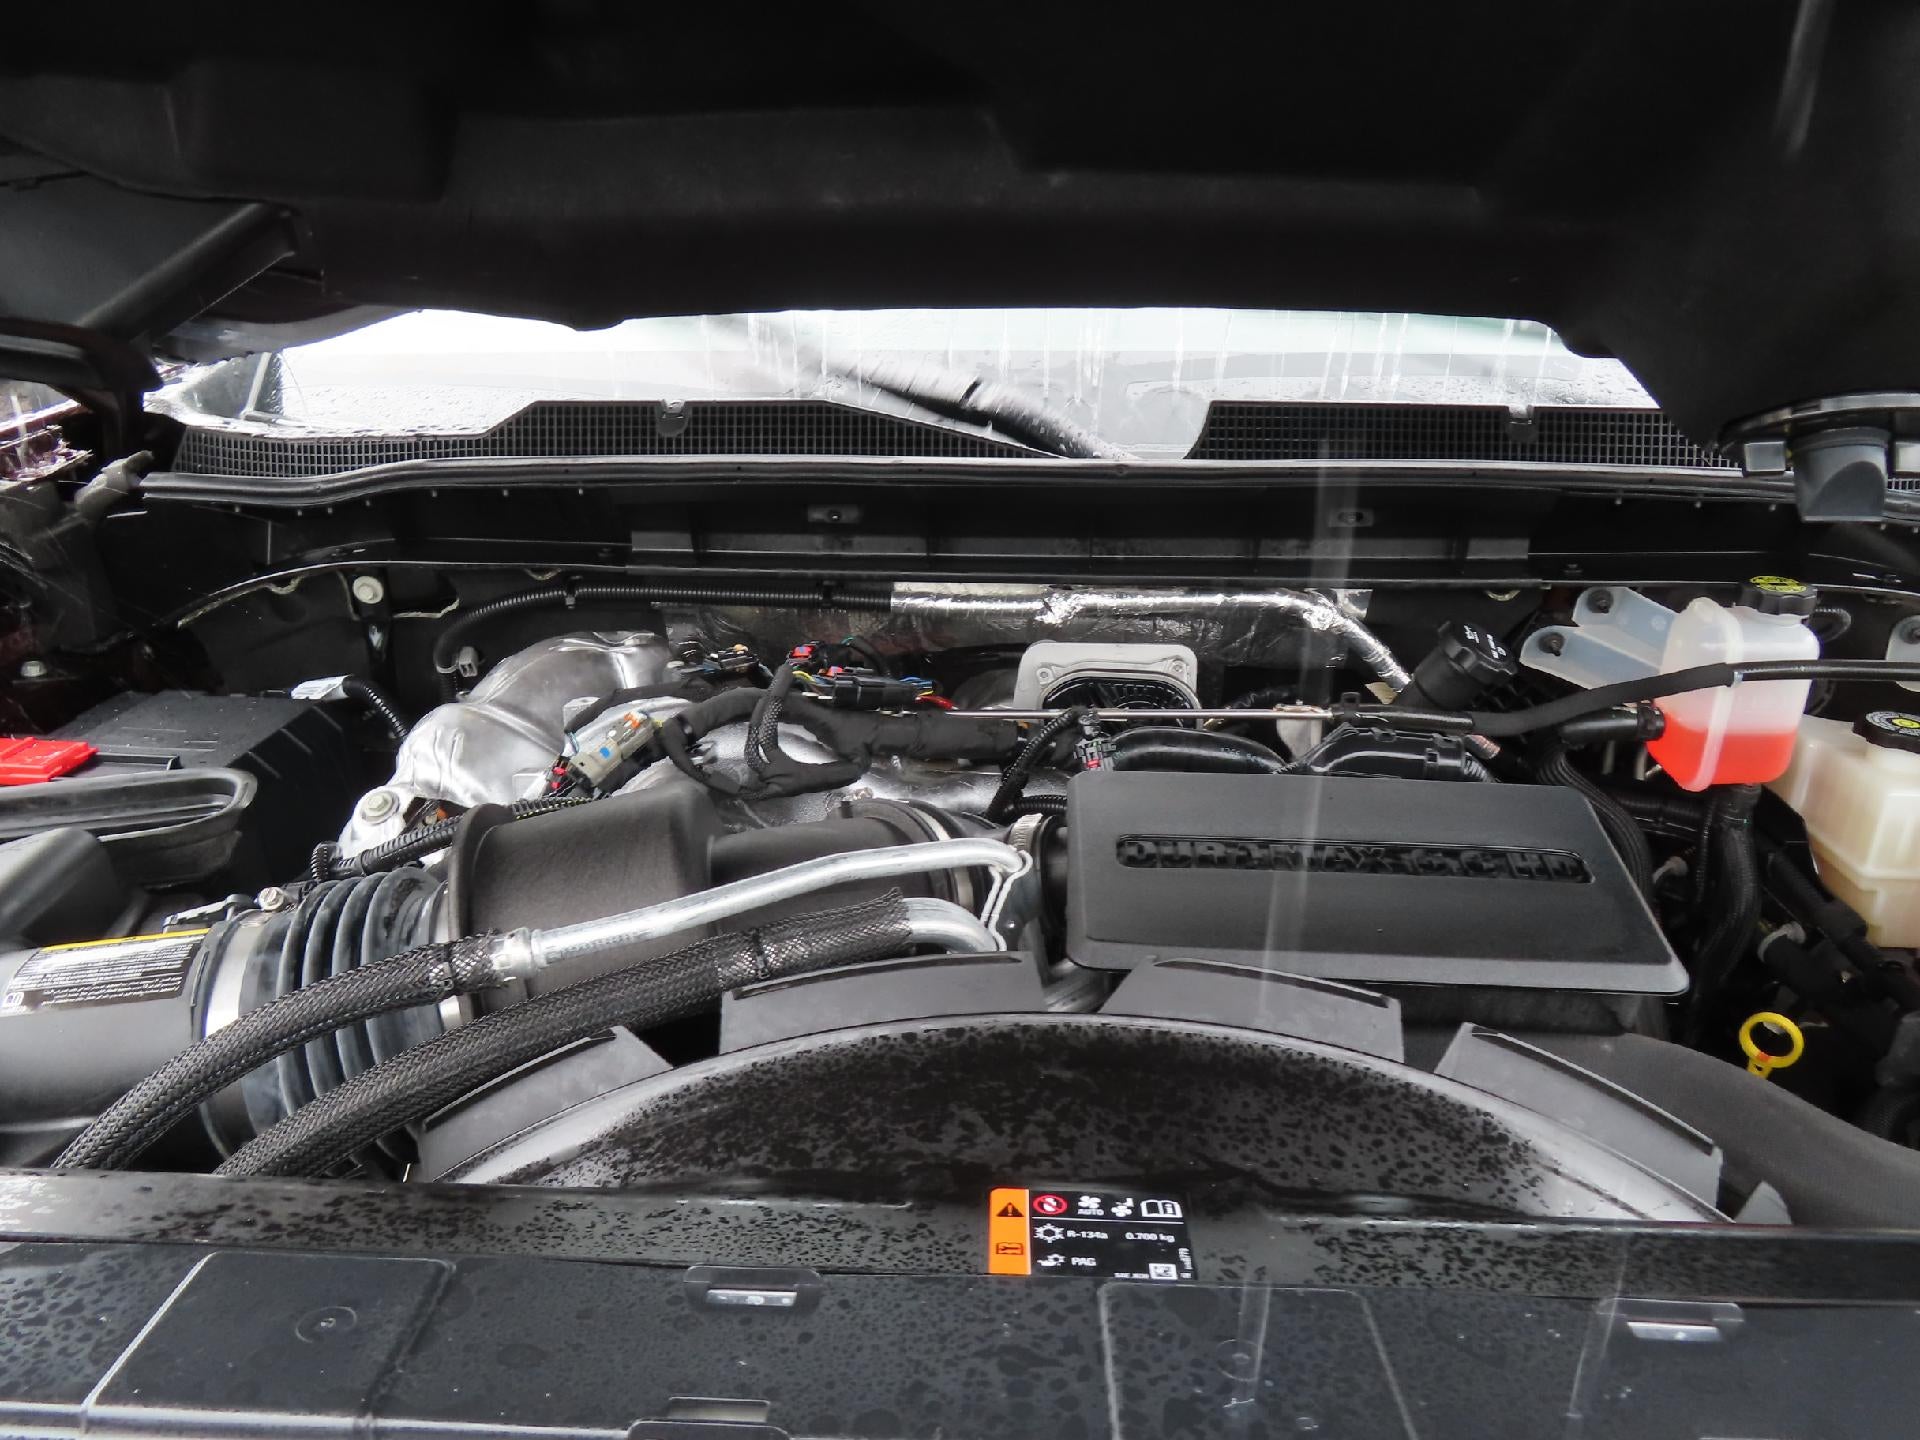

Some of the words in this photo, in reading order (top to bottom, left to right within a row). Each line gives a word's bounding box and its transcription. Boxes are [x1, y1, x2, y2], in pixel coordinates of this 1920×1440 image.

[1077, 1208, 1105, 1216] AUTO
[1067, 1230, 1109, 1240] R-134a
[1159, 1233, 1175, 1243] kg
[1071, 1257, 1097, 1267] PAG
